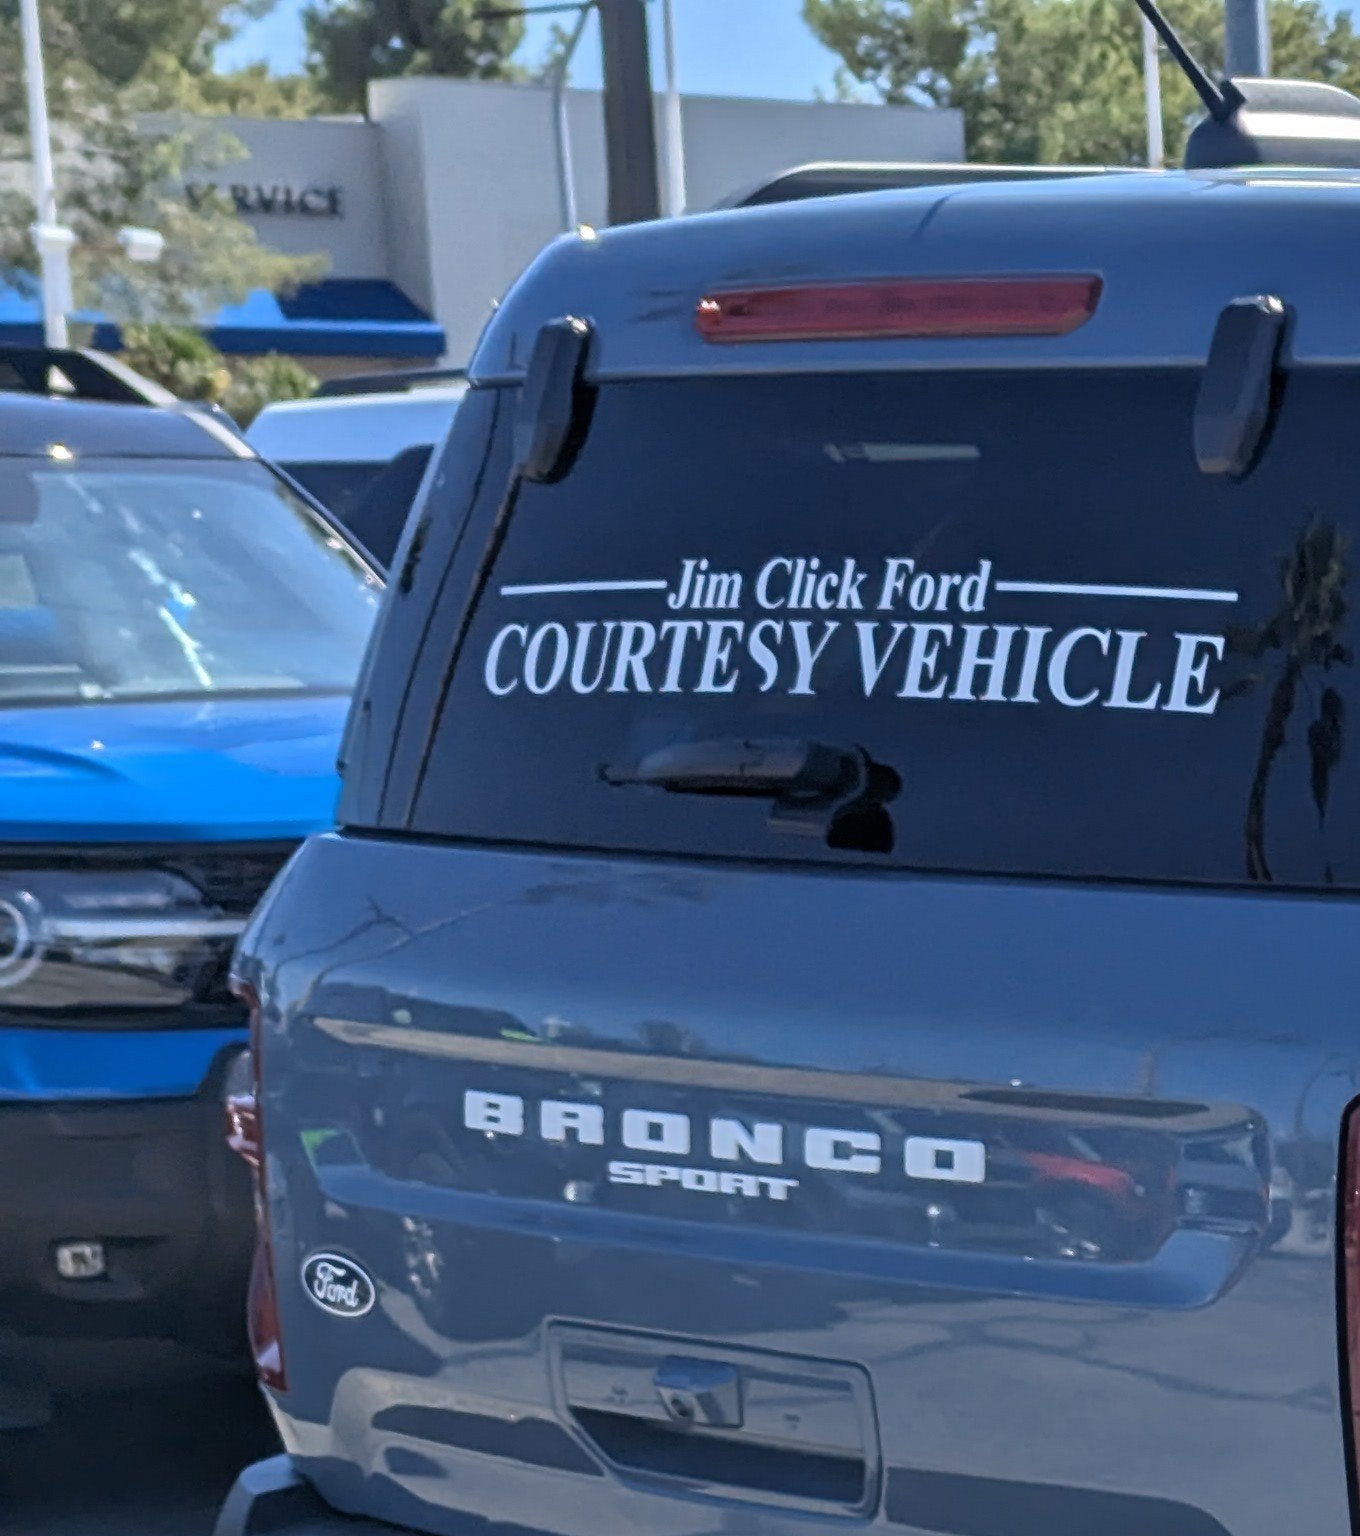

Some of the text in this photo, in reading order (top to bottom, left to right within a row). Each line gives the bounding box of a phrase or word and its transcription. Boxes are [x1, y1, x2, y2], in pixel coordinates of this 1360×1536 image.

[185, 184, 344, 219] RVICE
[667, 556, 992, 613] Jim Click Ford
[484, 618, 1226, 715] COURTESY VEHICLE
[464, 1090, 986, 1184] BRONCO
[608, 1160, 800, 1201] SPORT
[312, 1259, 359, 1308] Ford
